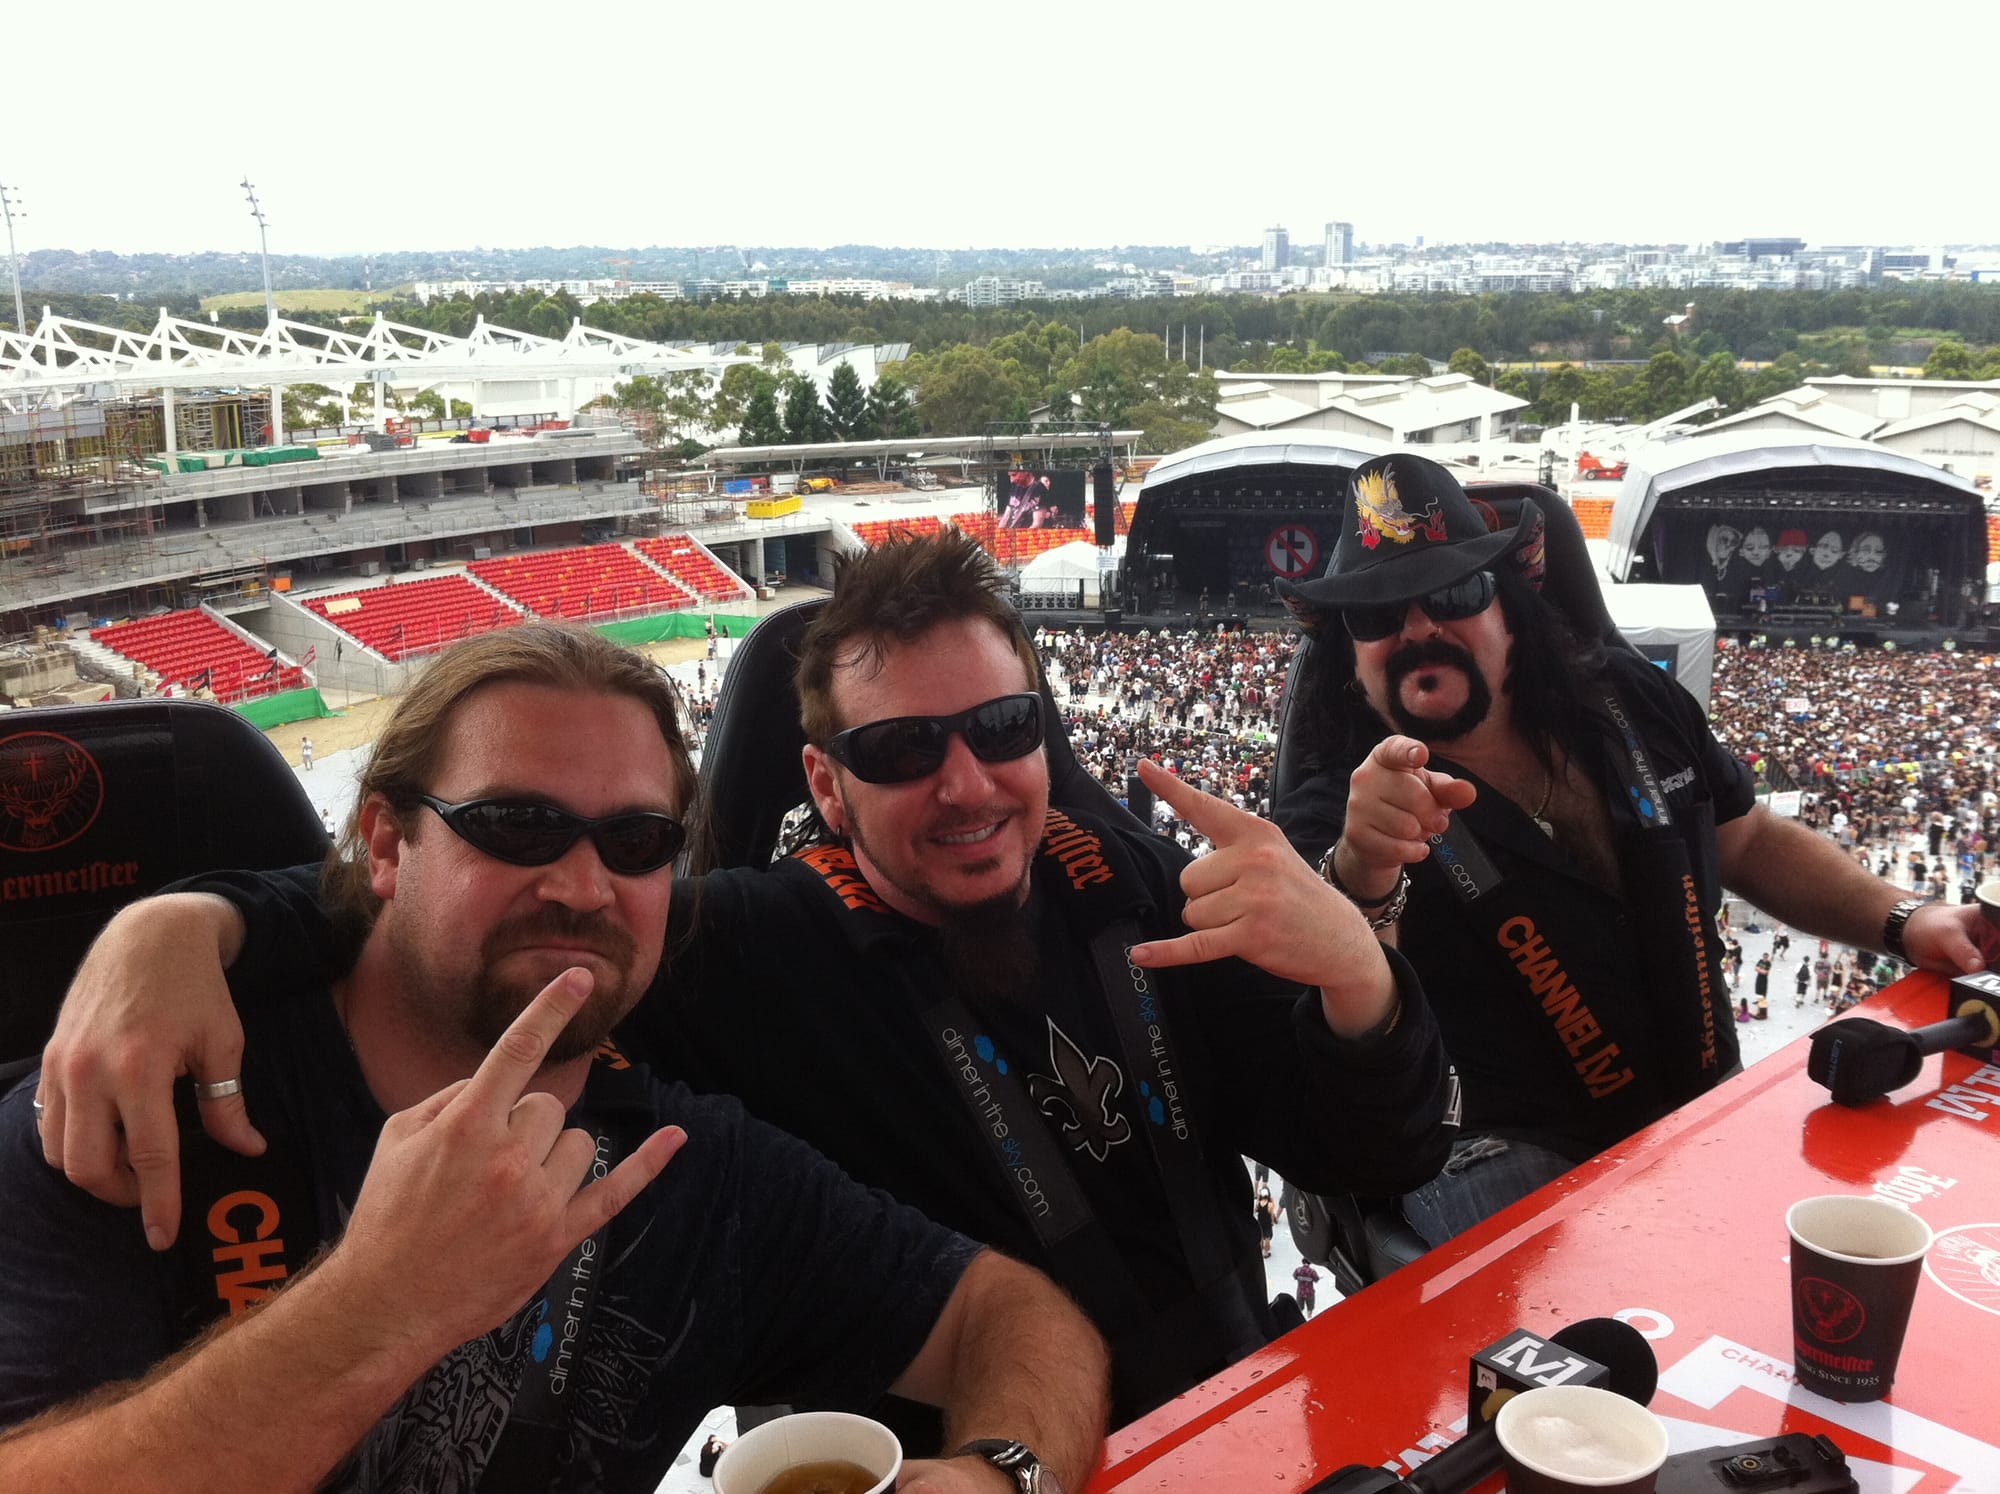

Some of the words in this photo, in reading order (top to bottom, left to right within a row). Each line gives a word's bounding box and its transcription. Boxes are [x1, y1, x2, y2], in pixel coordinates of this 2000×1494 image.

[1497, 915, 1602, 1058] CHANNEL
[1148, 1024, 1166, 1058] the
[1157, 1059, 1172, 1079] in
[942, 1028, 982, 1085] dinner
[973, 1083, 991, 1106] in
[985, 1103, 1008, 1138] the
[1002, 1138, 1050, 1217] sky.com
[1162, 1080, 1189, 1140] dinner
[572, 1238, 597, 1281] the
[566, 1287, 588, 1309] in
[549, 1309, 581, 1394] dinner
[1856, 1375, 1880, 1386] 1935
